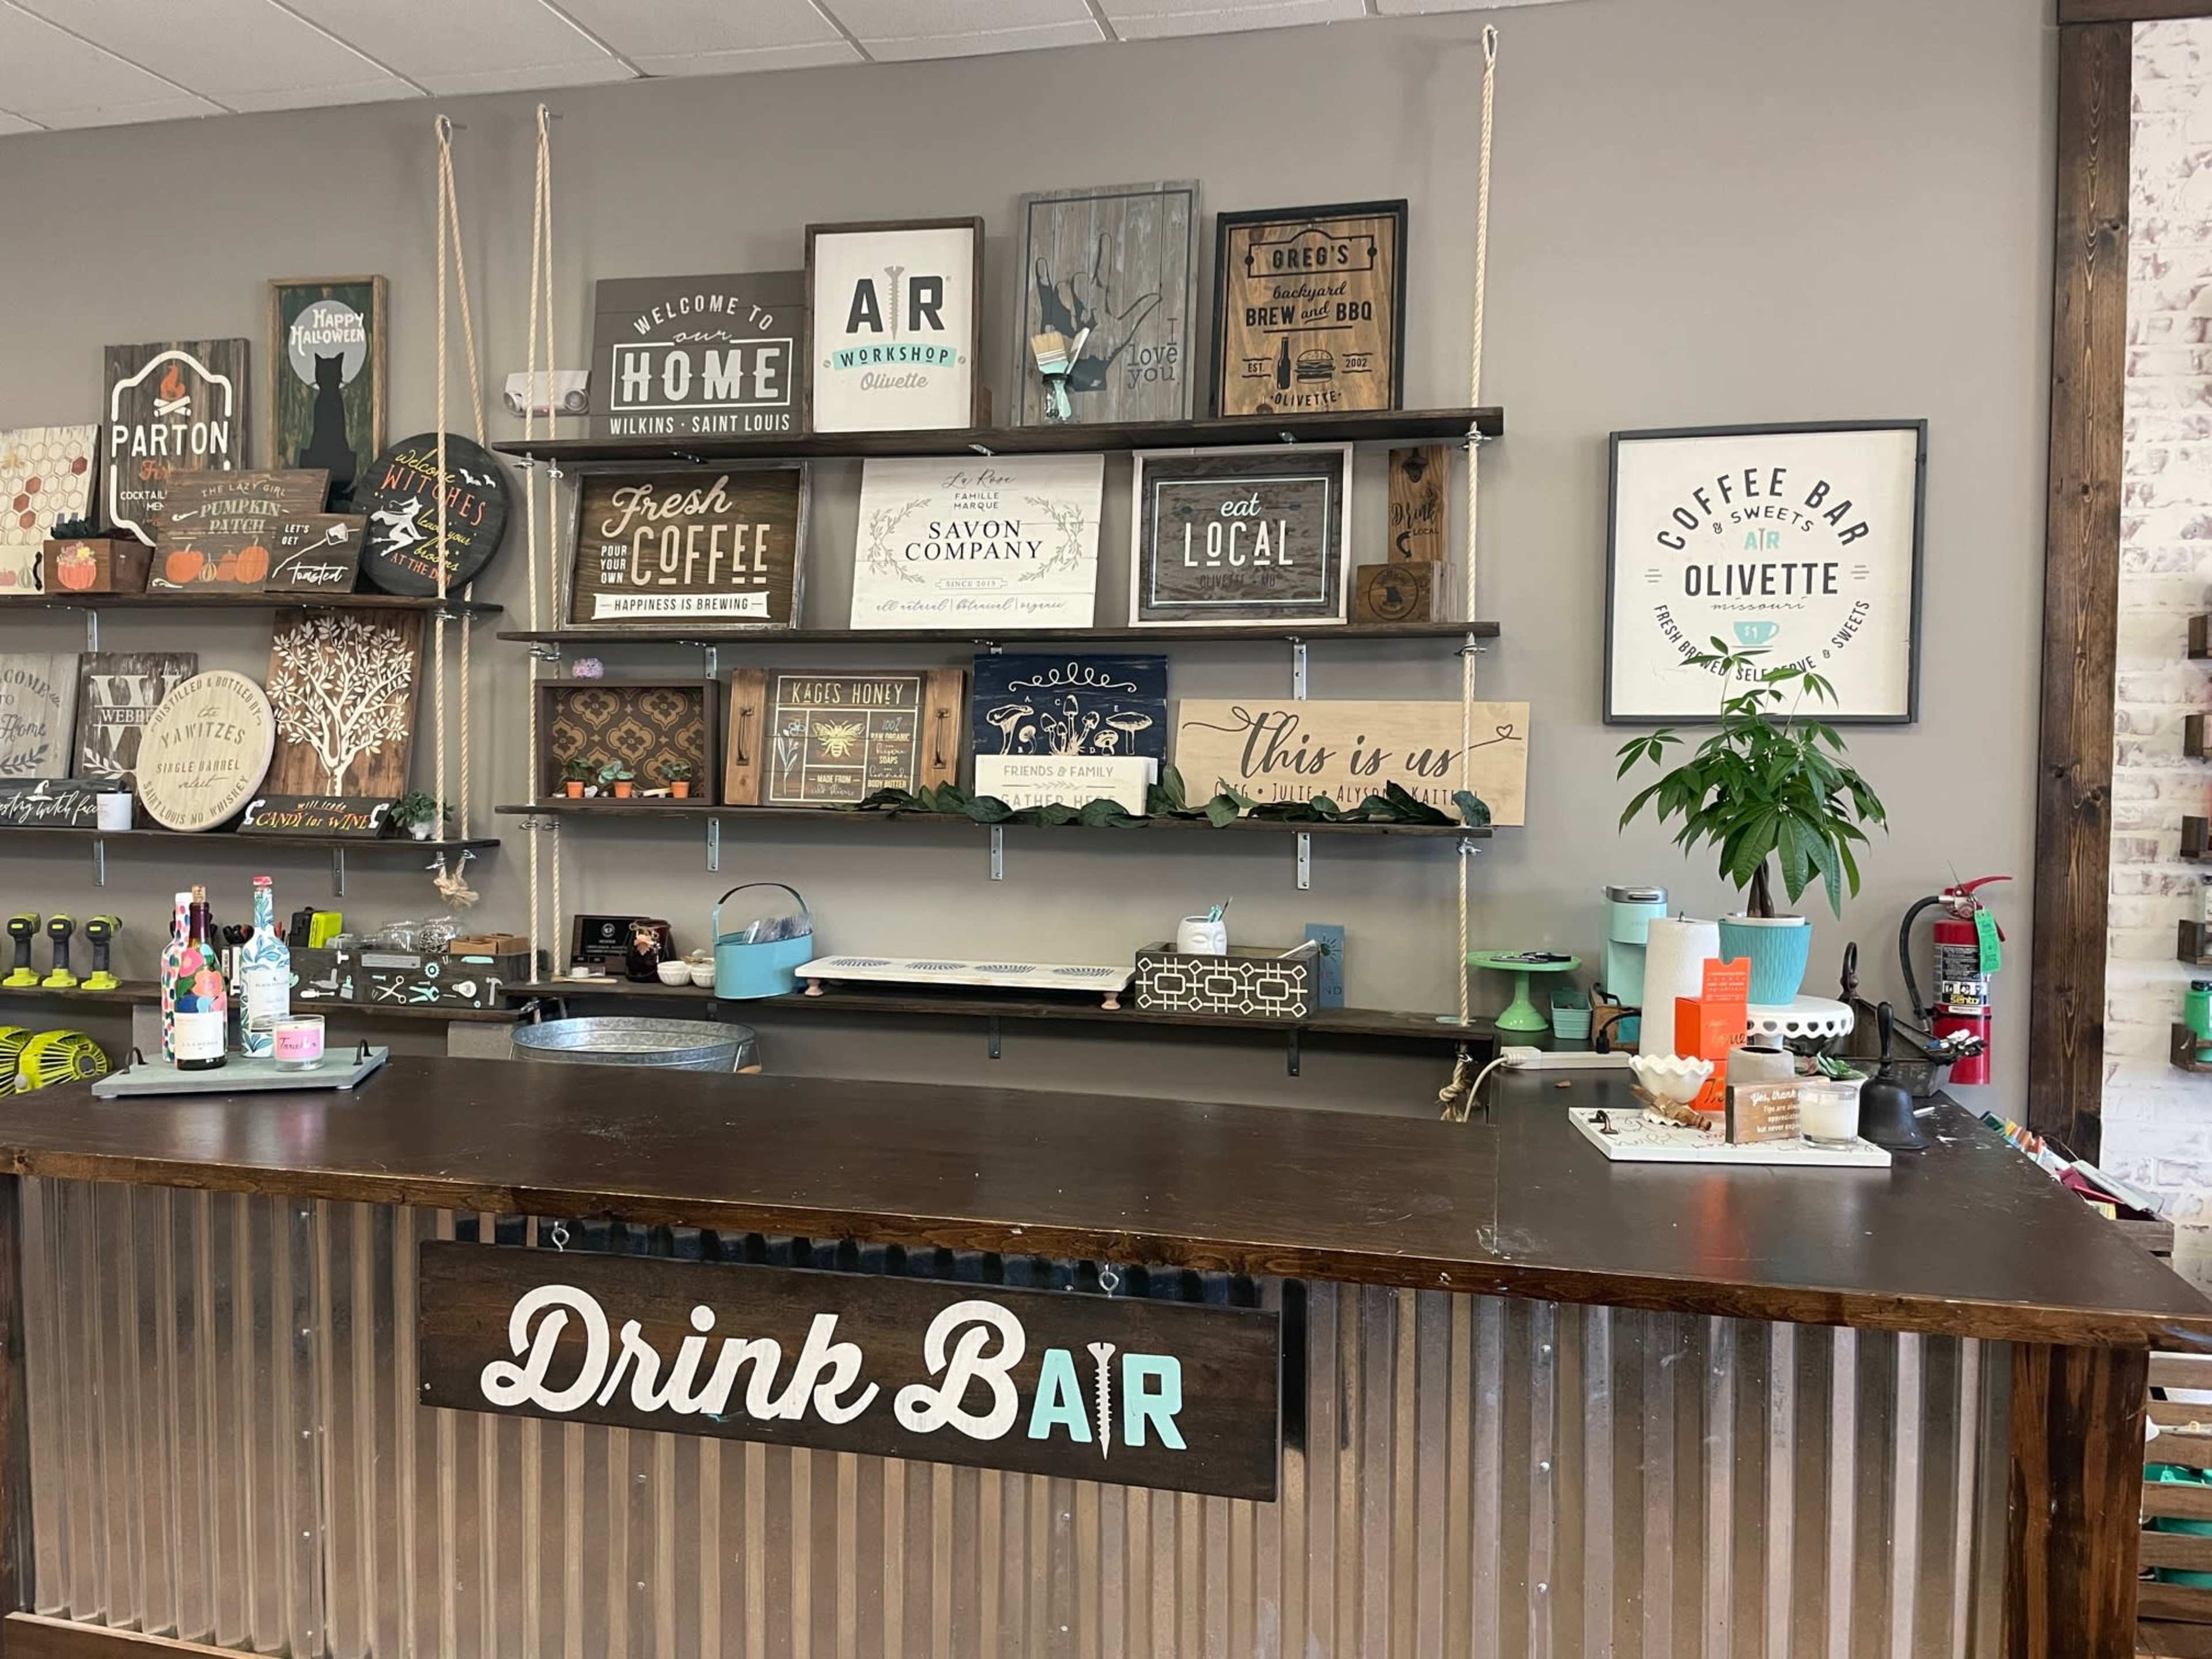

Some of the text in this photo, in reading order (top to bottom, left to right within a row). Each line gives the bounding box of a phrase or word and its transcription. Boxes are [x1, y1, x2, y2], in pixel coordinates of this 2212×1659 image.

[1272, 244, 1350, 270] GREG'S
[1272, 281, 1347, 302] backyard
[633, 294, 773, 335] WELCOME TO
[1245, 301, 1373, 327] BREW and BBQ
[672, 329, 733, 343] our
[1166, 317, 1178, 346] I
[840, 347, 949, 368] WORKSHOP
[1128, 344, 1178, 366] love
[1345, 358, 1368, 368] 2002
[620, 347, 781, 403] HOME
[860, 372, 929, 391] Olivette
[1127, 365, 1175, 389] you
[1274, 391, 1337, 407] OLIVETTE
[610, 414, 790, 435] WILKINS SAINT LOUIS
[111, 421, 229, 458] PARTON
[976, 468, 1016, 486] Rose
[202, 479, 286, 498] THE LAZY GIRL
[380, 464, 487, 527] WITCHES
[955, 492, 1000, 501] FAMILLE
[199, 499, 282, 518] PUMPKIN
[601, 474, 733, 539] Fresh
[953, 501, 999, 512] MARQUE
[1220, 492, 1262, 517] eat
[1657, 467, 1870, 551] COFFEE BAR
[208, 518, 266, 535] PATCH
[1730, 505, 1814, 532] SWEETS
[284, 524, 310, 534] LET'S
[928, 520, 1022, 540] SAVON
[1412, 528, 1440, 536] LOCAL
[601, 545, 627, 557] POUR
[904, 540, 1044, 561] COMPANY
[1184, 520, 1294, 567] LOCAL
[390, 552, 407, 565] AT
[407, 558, 430, 575] THE
[600, 559, 626, 571] YOUR
[630, 524, 771, 586] COFFEE
[600, 572, 624, 584] OWN
[1684, 562, 1839, 597] OLIVETTE
[614, 597, 749, 611] HAPPINESS IS BREWING
[876, 597, 1069, 614] all natural botanical organic
[1710, 596, 1807, 611] missouri
[1654, 604, 1683, 643] FRESH
[1831, 600, 1870, 649] SWEETS
[154, 679, 202, 724] DISTILLED
[215, 676, 254, 703] BOTTLED
[791, 683, 904, 706] KAGES HONEY
[881, 717, 903, 732] 100%
[161, 721, 246, 749] YAWITZES
[870, 733, 910, 742] RAW ORGANIC
[878, 756, 899, 764] SOAPS
[1350, 734, 1393, 776] is
[1405, 748, 1463, 777] us
[156, 759, 241, 774] SINGLE BARREL
[1003, 765, 1113, 777] FRIENDS & FAMILY
[817, 775, 851, 784] MADE FROM
[867, 779, 907, 789] BODY BUTTER
[143, 775, 249, 825] SAINT LOUIS MO WHISKEY
[1272, 782, 1313, 802] JULIE
[297, 800, 318, 809] will
[256, 811, 307, 828] CANDY
[328, 813, 372, 830] WINE
[480, 1284, 880, 1426] Drink
